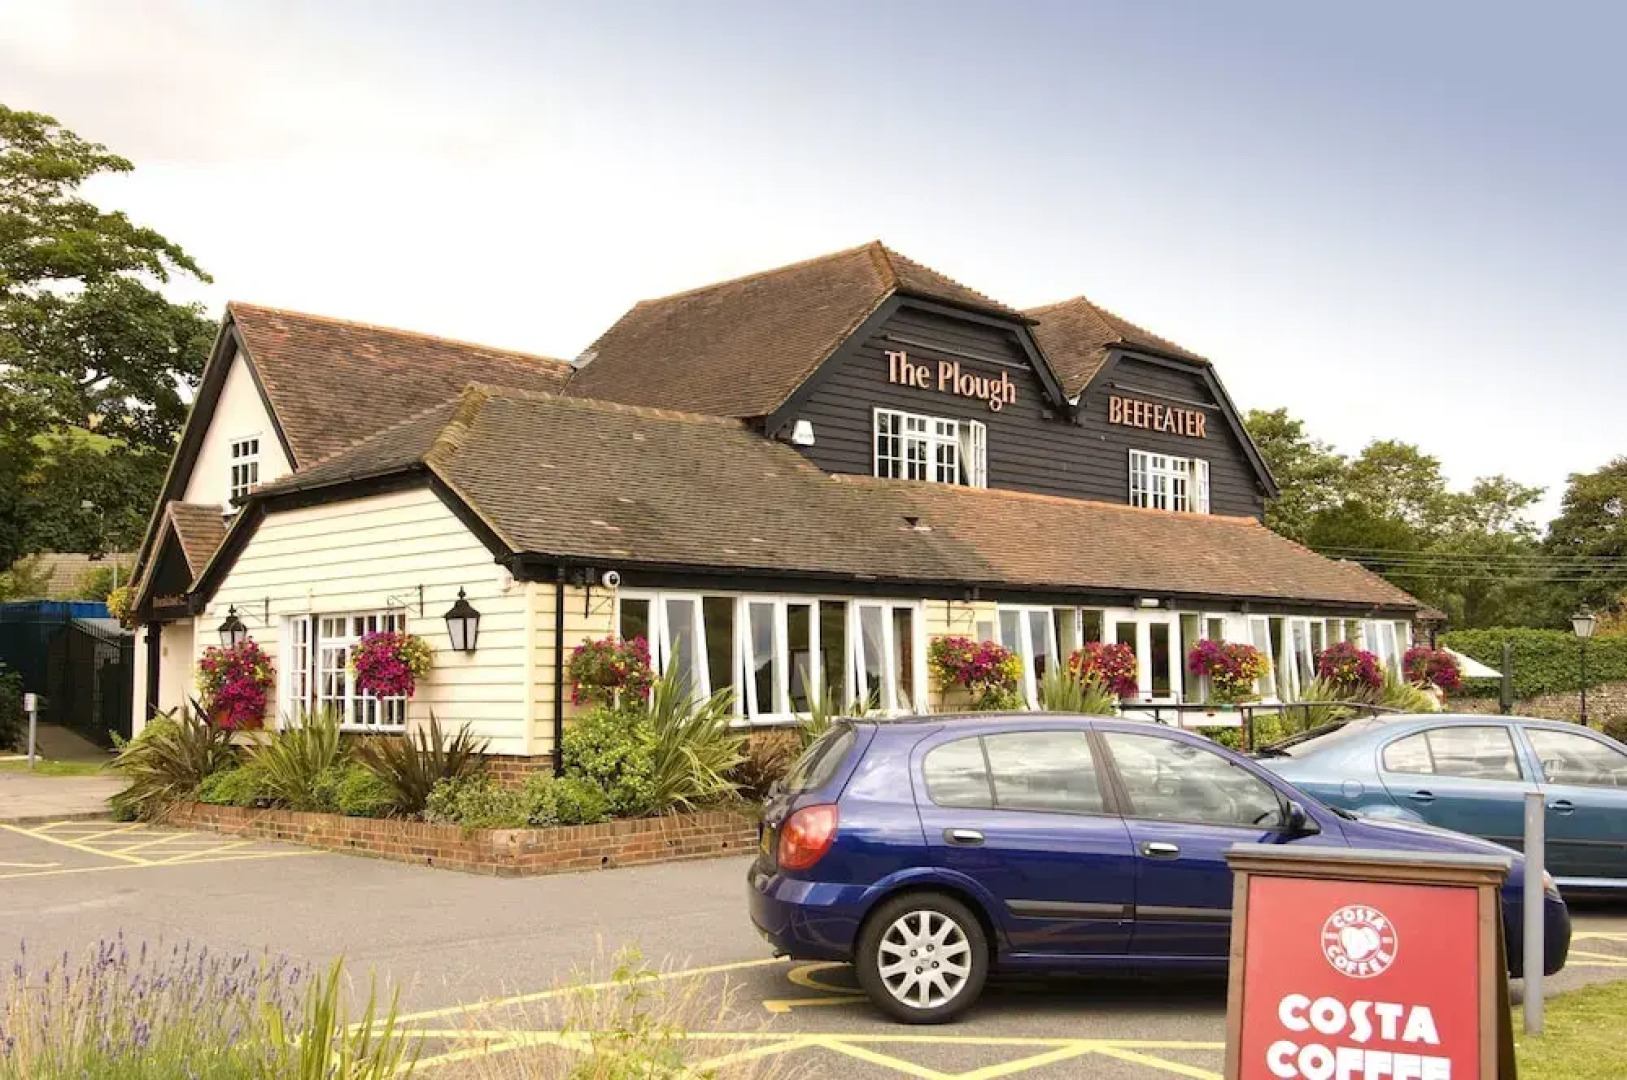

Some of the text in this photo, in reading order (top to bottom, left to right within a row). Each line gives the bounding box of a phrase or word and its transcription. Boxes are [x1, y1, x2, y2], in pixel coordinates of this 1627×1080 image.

[885, 351, 1016, 411] The Plough
[1108, 396, 1207, 438] BEEFEATER
[1331, 908, 1388, 931] COSTA
[1327, 944, 1392, 976] COFFEE
[1278, 993, 1440, 1045] COSTA
